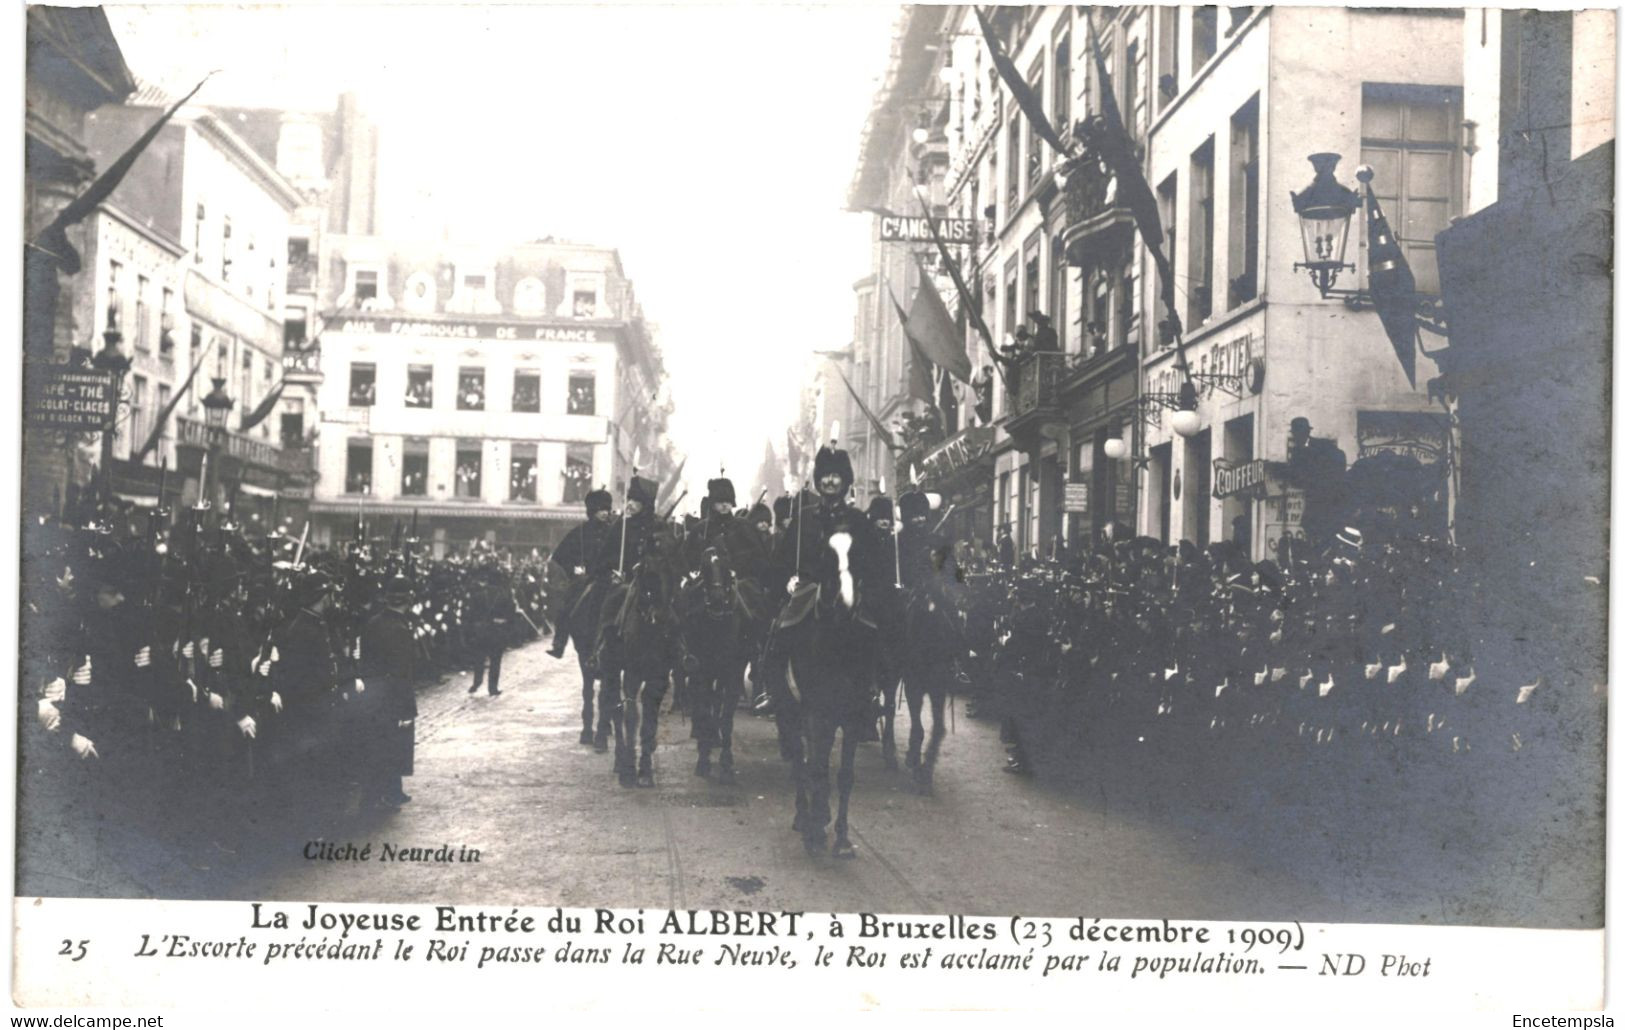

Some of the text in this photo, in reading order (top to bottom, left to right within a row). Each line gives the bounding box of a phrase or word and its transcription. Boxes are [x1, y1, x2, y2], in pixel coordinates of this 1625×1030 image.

[898, 218, 974, 239] ANGAISE
[341, 319, 597, 343] AUX FABRIQUES DE FRANCE
[1216, 459, 1265, 497] COIFFEUR
